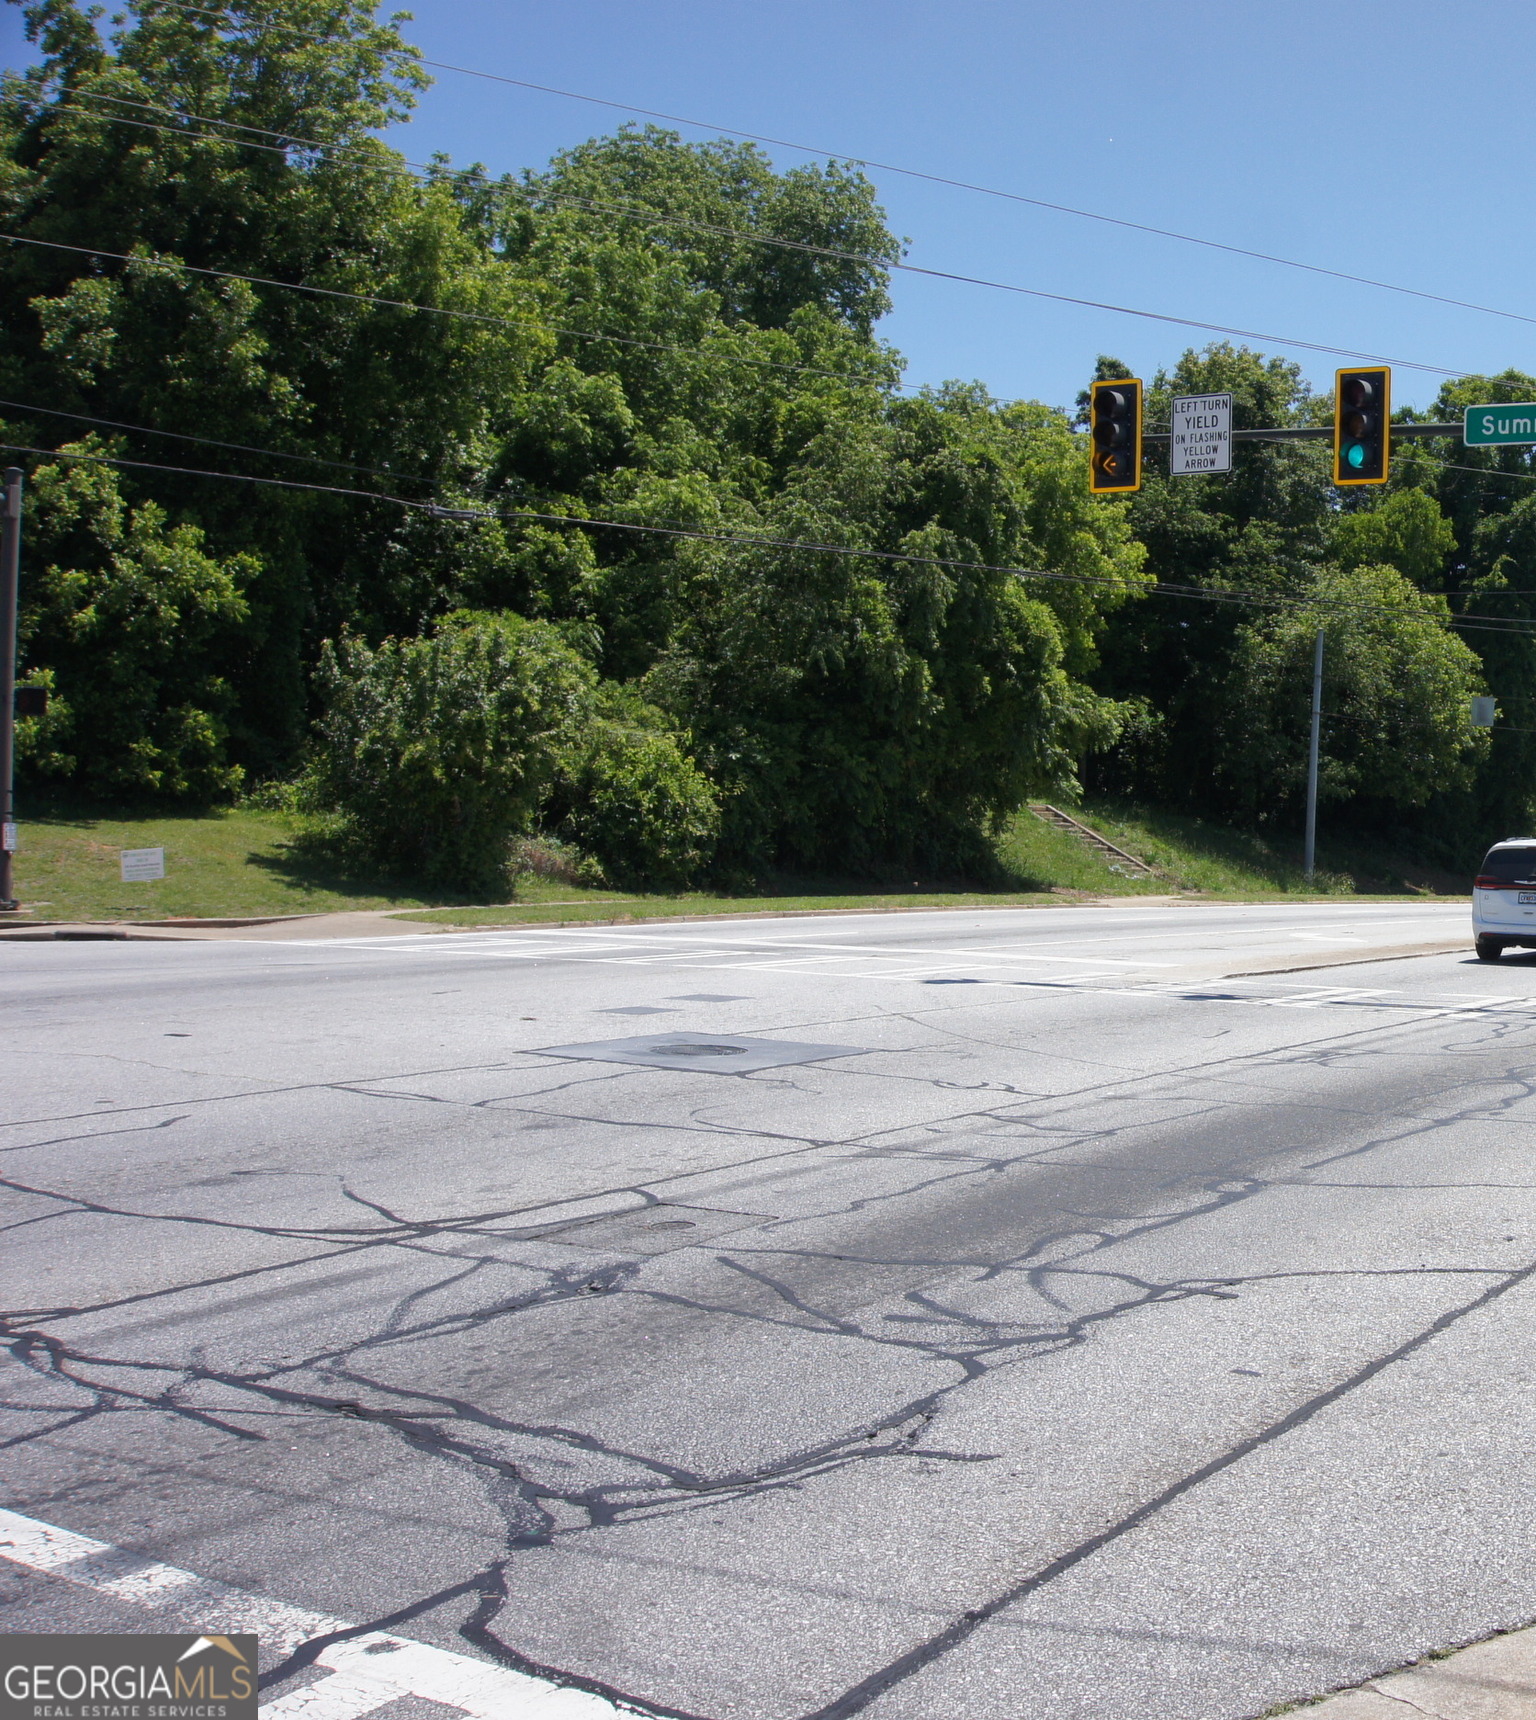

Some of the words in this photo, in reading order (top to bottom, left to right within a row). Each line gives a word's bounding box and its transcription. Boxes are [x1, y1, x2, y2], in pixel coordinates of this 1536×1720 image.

[1175, 401, 1198, 414] LEFT
[1201, 398, 1228, 411] TURN
[1185, 414, 1219, 430] YIELD
[1175, 434, 1186, 445] ON
[1190, 431, 1228, 443] FLASHING
[1183, 445, 1219, 457] YELLOW
[1184, 457, 1216, 469] ARROW
